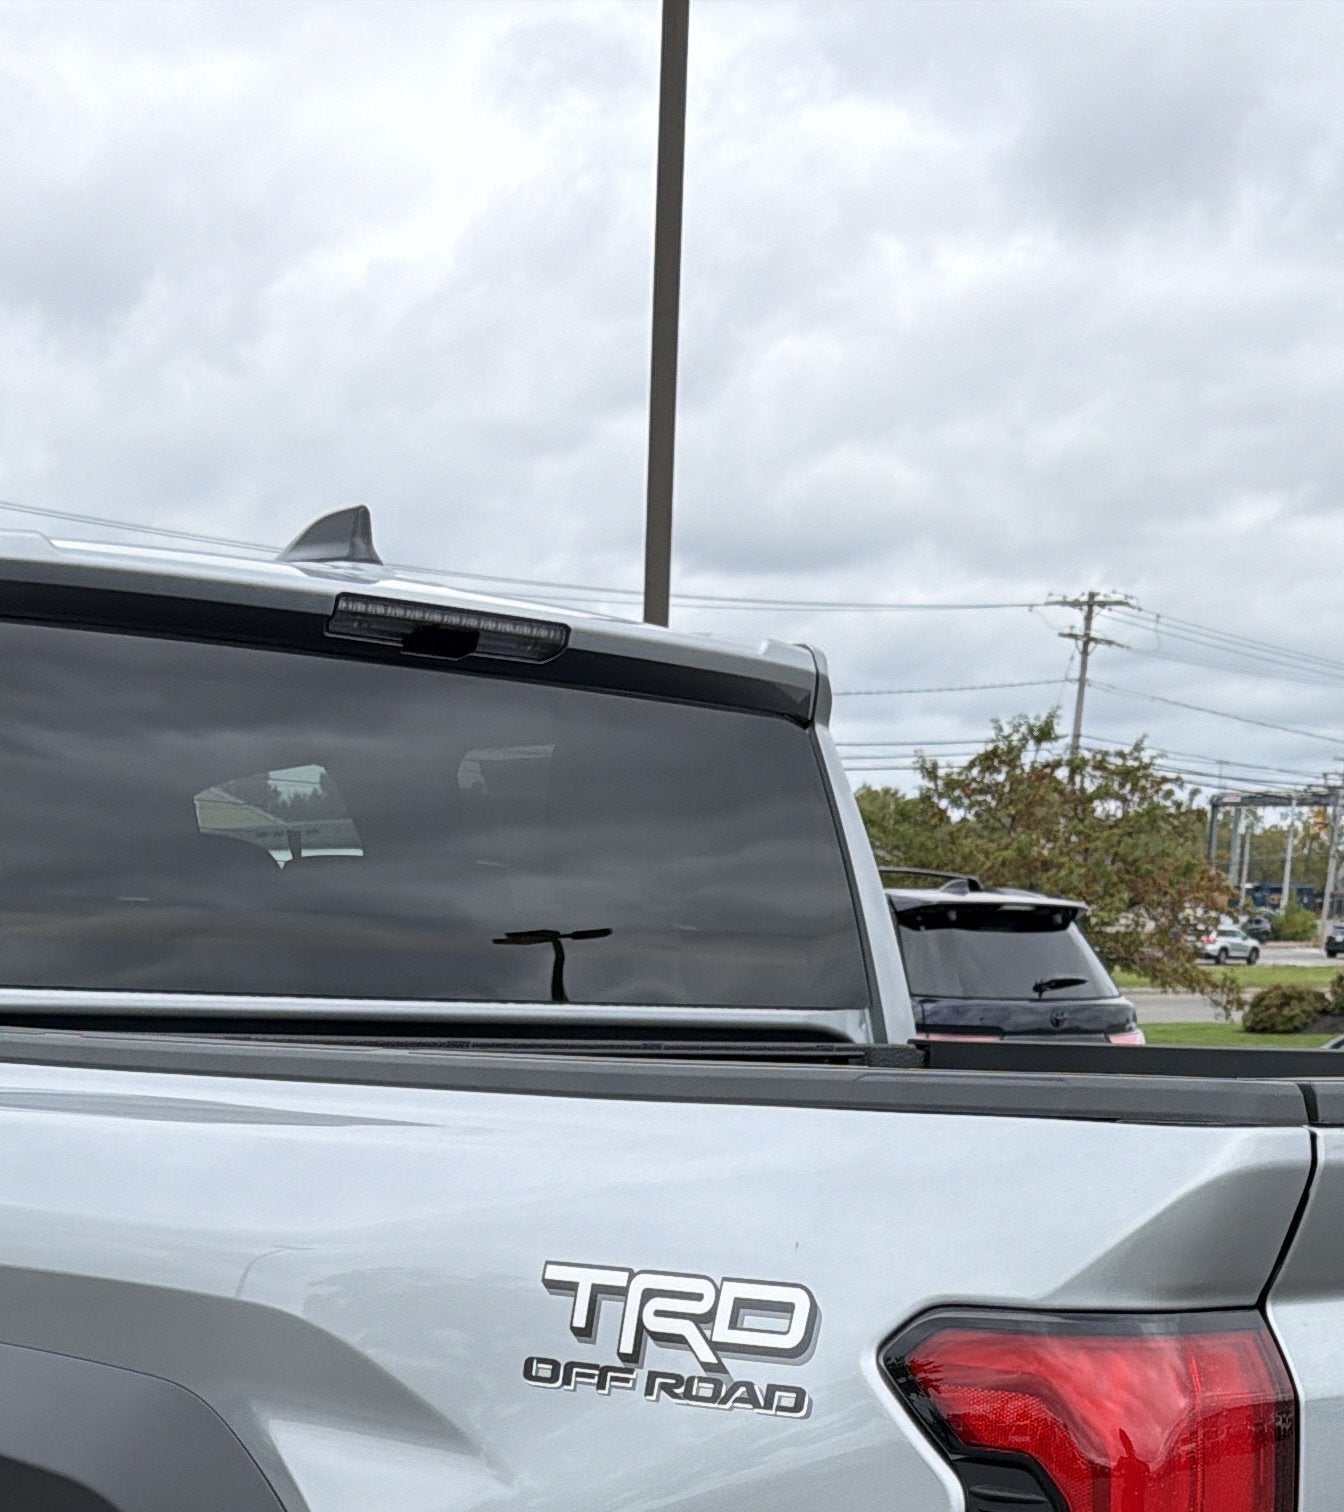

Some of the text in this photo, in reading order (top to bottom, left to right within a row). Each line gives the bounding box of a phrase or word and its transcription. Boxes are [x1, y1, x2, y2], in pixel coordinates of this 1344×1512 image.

[541, 1259, 822, 1381] TRD
[522, 1355, 814, 1419] OFF ROAD
